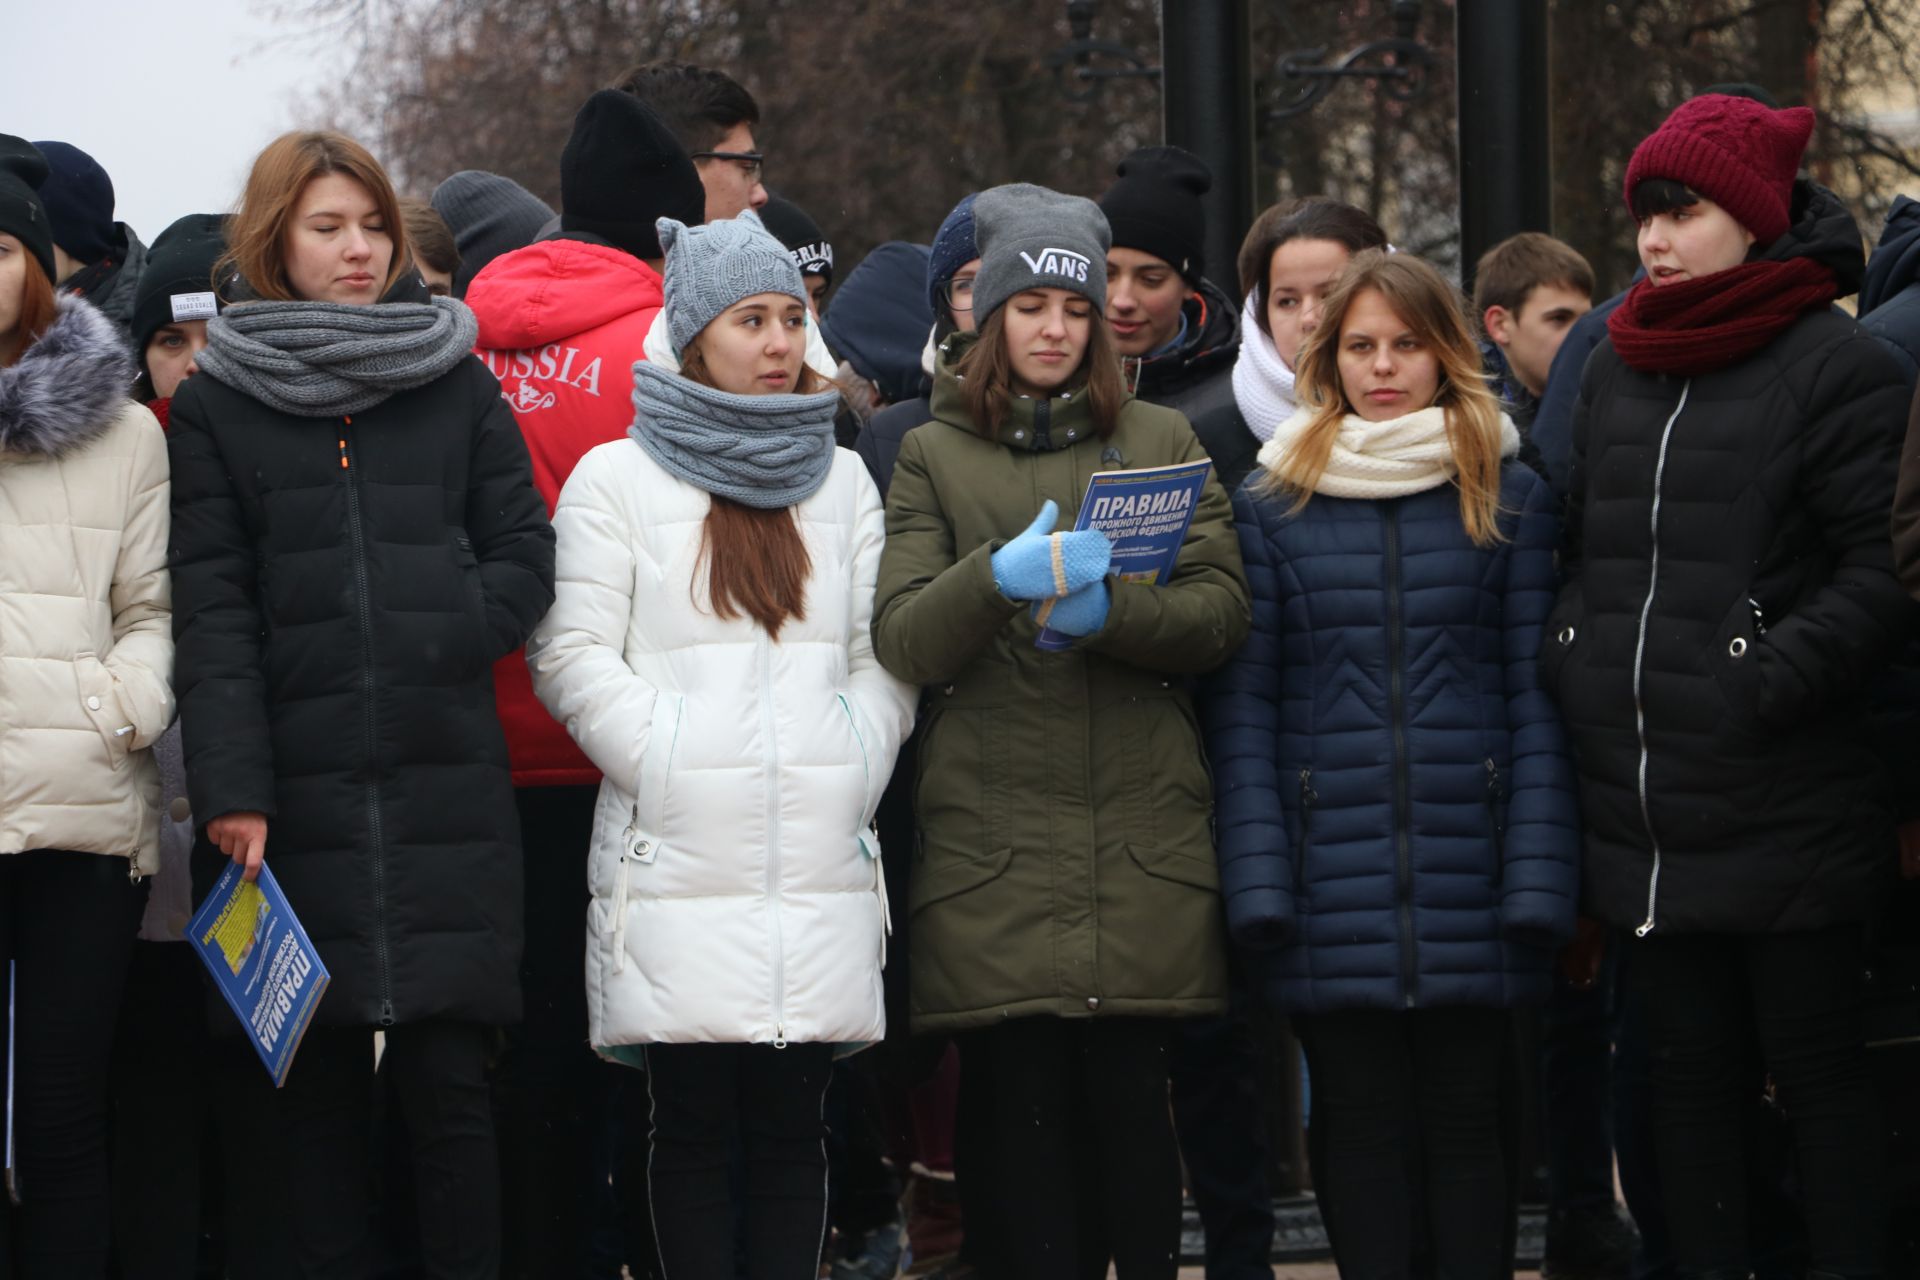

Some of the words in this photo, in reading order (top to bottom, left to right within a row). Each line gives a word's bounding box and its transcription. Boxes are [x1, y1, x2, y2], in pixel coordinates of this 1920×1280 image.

[1019, 248, 1091, 282] VANS
[477, 344, 602, 396] USSIA
[1089, 517, 1142, 529] ДОРОЖНОГО
[1141, 510, 1188, 526] ДВИЖЕНИЯ
[1091, 488, 1192, 519] ПРАВИЛА
[1139, 521, 1184, 536] ФЕДЕРАЦИИ
[272, 938, 299, 992] ДОРОЖНОГО
[260, 948, 312, 1053] ПРАВИЛА
